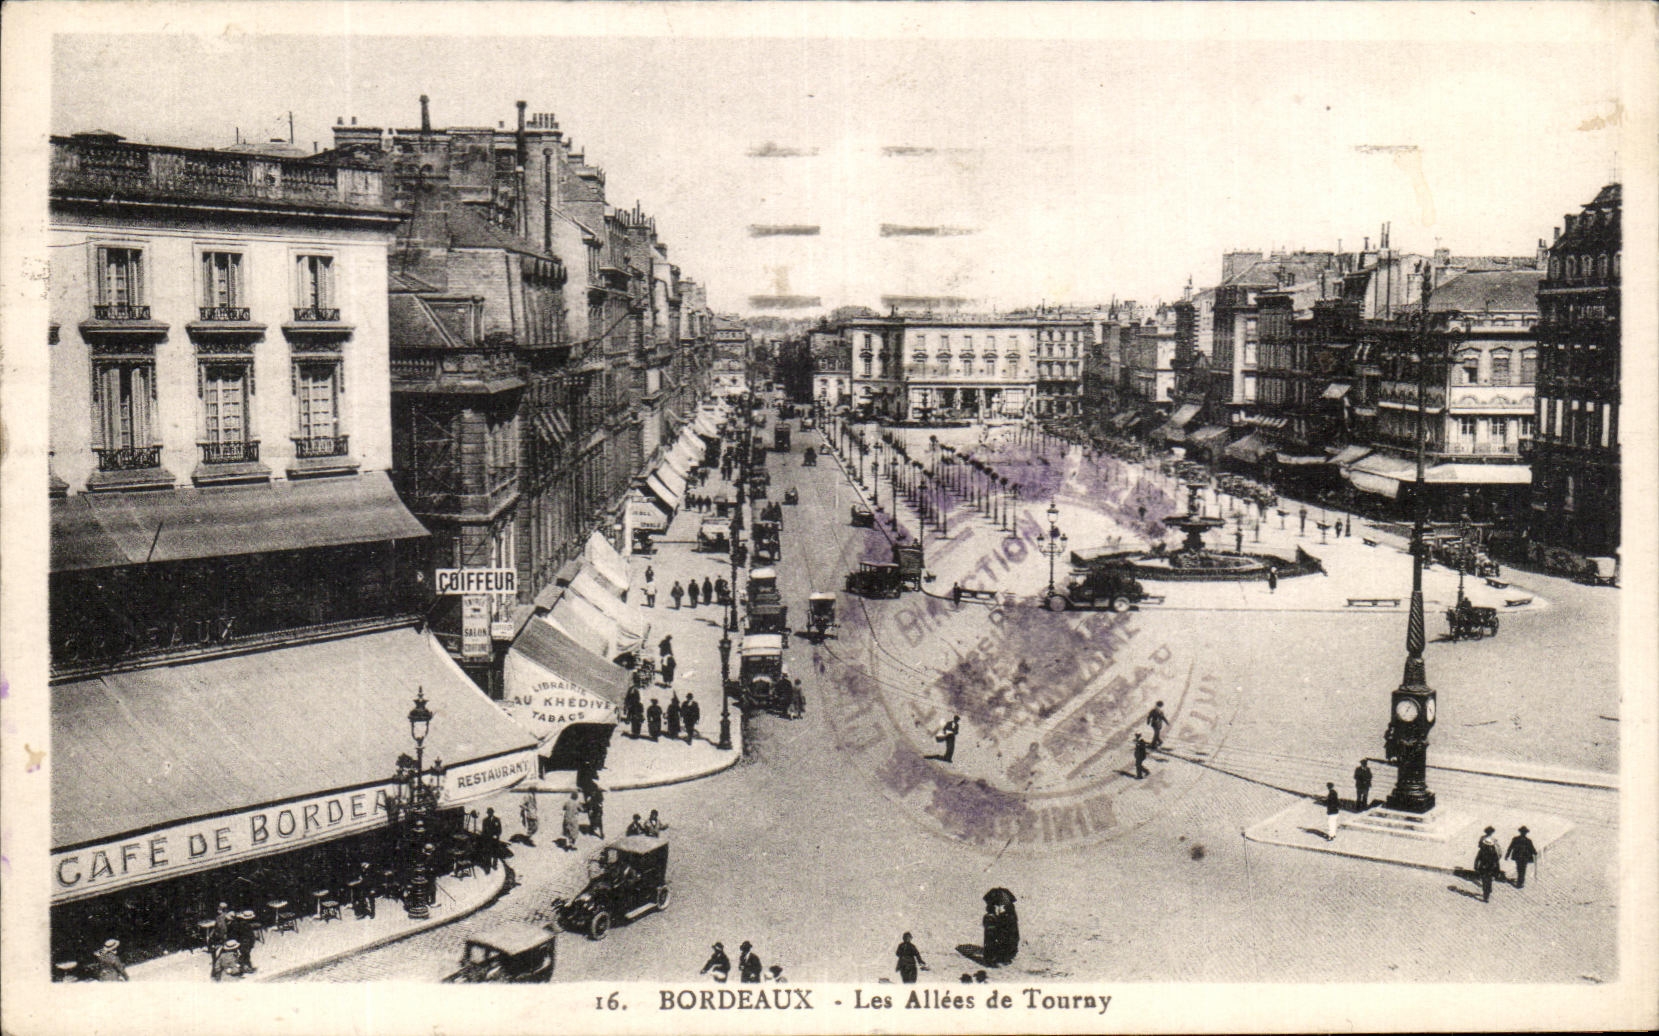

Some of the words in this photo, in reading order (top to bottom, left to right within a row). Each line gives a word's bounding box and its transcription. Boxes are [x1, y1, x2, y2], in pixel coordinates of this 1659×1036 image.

[439, 572, 514, 591] COIFFEUR
[464, 628, 487, 638] SALON
[532, 681, 587, 696] LIBRAIRIE
[514, 695, 532, 706] AU
[532, 710, 585, 722] TABACS
[457, 759, 529, 789] RESTAURANT
[56, 834, 169, 888] CAFÉ
[188, 826, 232, 860] DE
